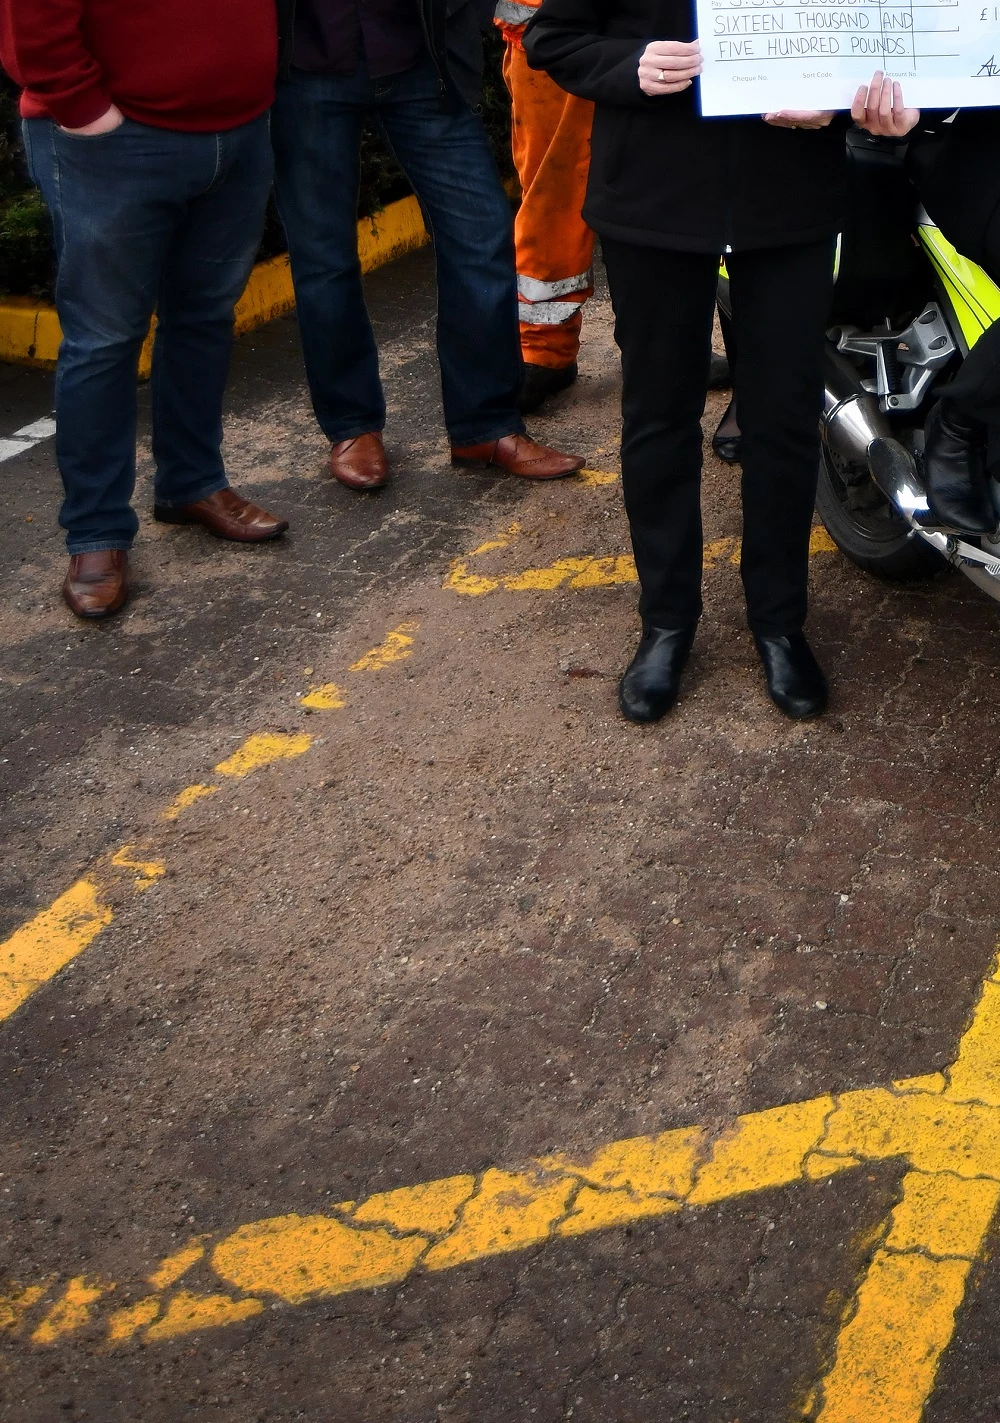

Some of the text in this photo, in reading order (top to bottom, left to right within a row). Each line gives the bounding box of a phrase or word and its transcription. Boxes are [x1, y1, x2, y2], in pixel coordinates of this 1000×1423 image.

[713, 11, 914, 34] SIXTEEN THOUSAND AND
[718, 40, 754, 58] FIVE
[768, 36, 840, 56] HUNDRED
